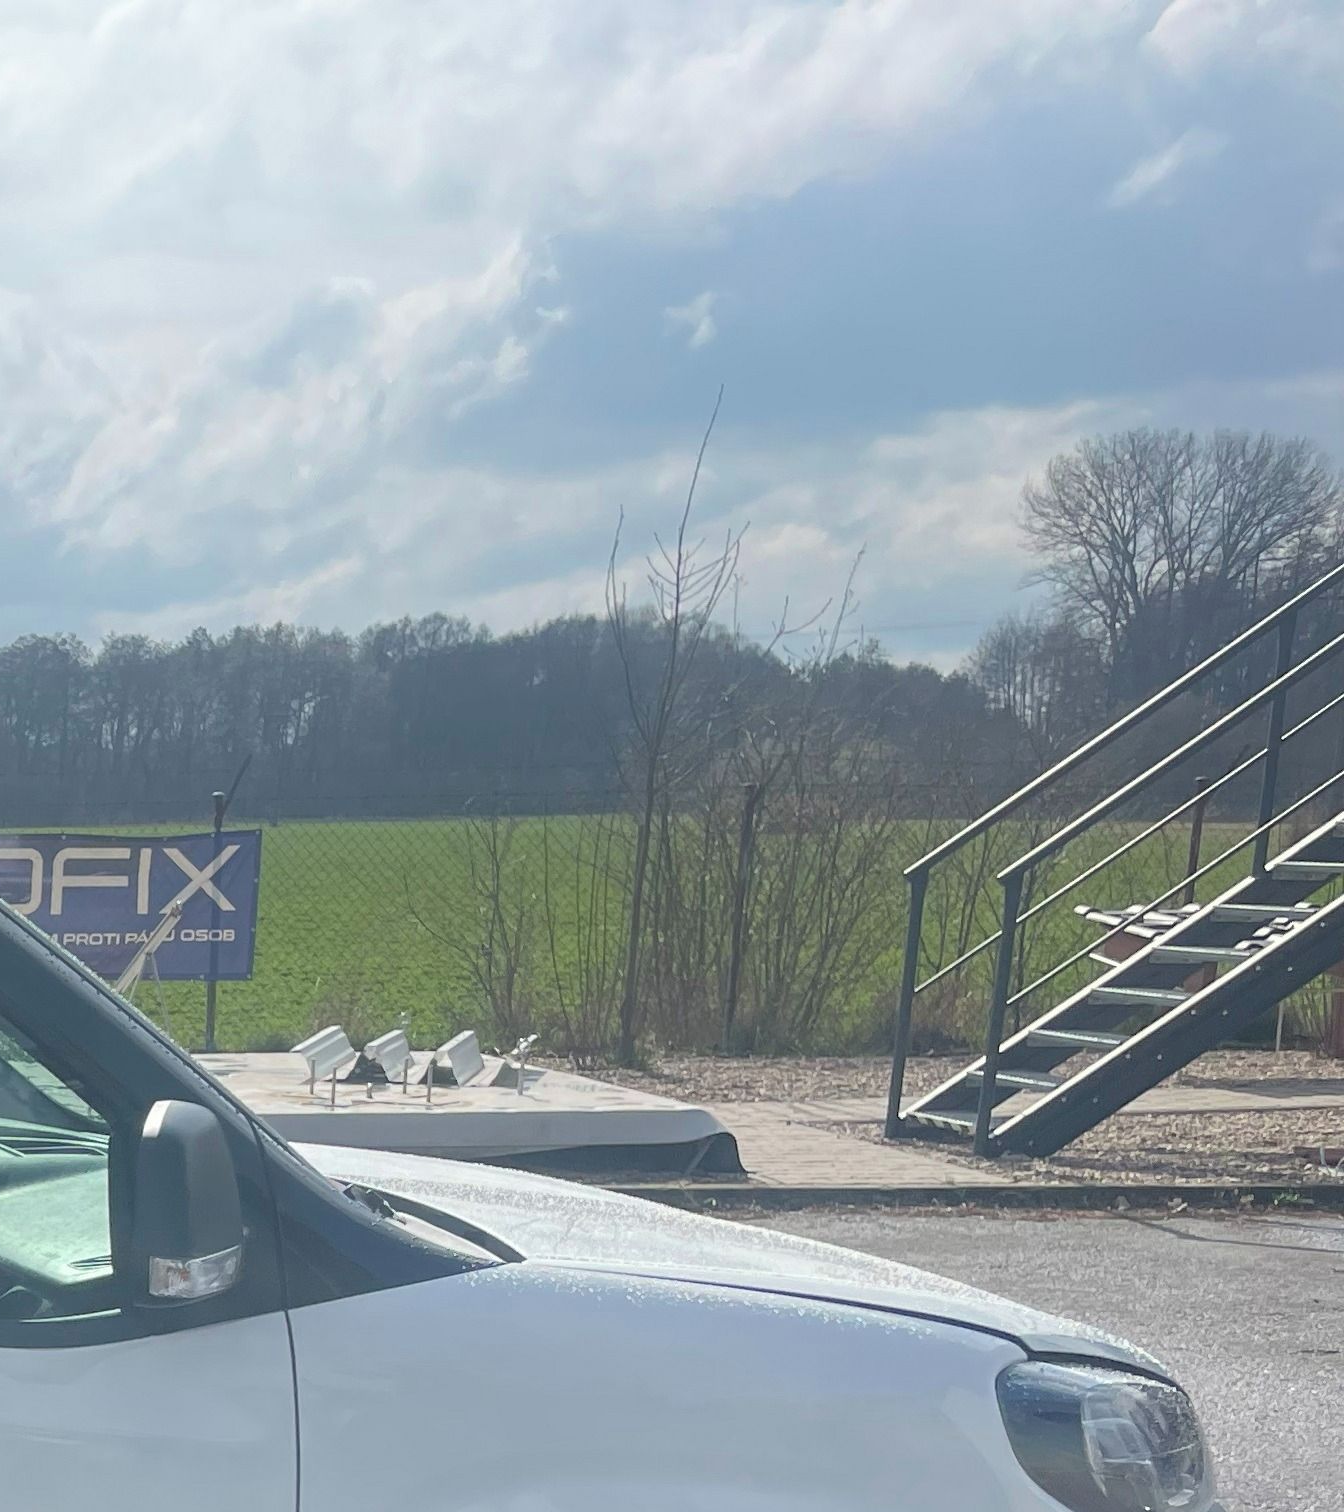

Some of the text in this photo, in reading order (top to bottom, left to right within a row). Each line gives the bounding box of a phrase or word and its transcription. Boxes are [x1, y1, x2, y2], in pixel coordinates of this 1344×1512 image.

[63, 933, 120, 945] PROTI
[125, 929, 175, 944] PÁU
[180, 929, 235, 941] OSOB
